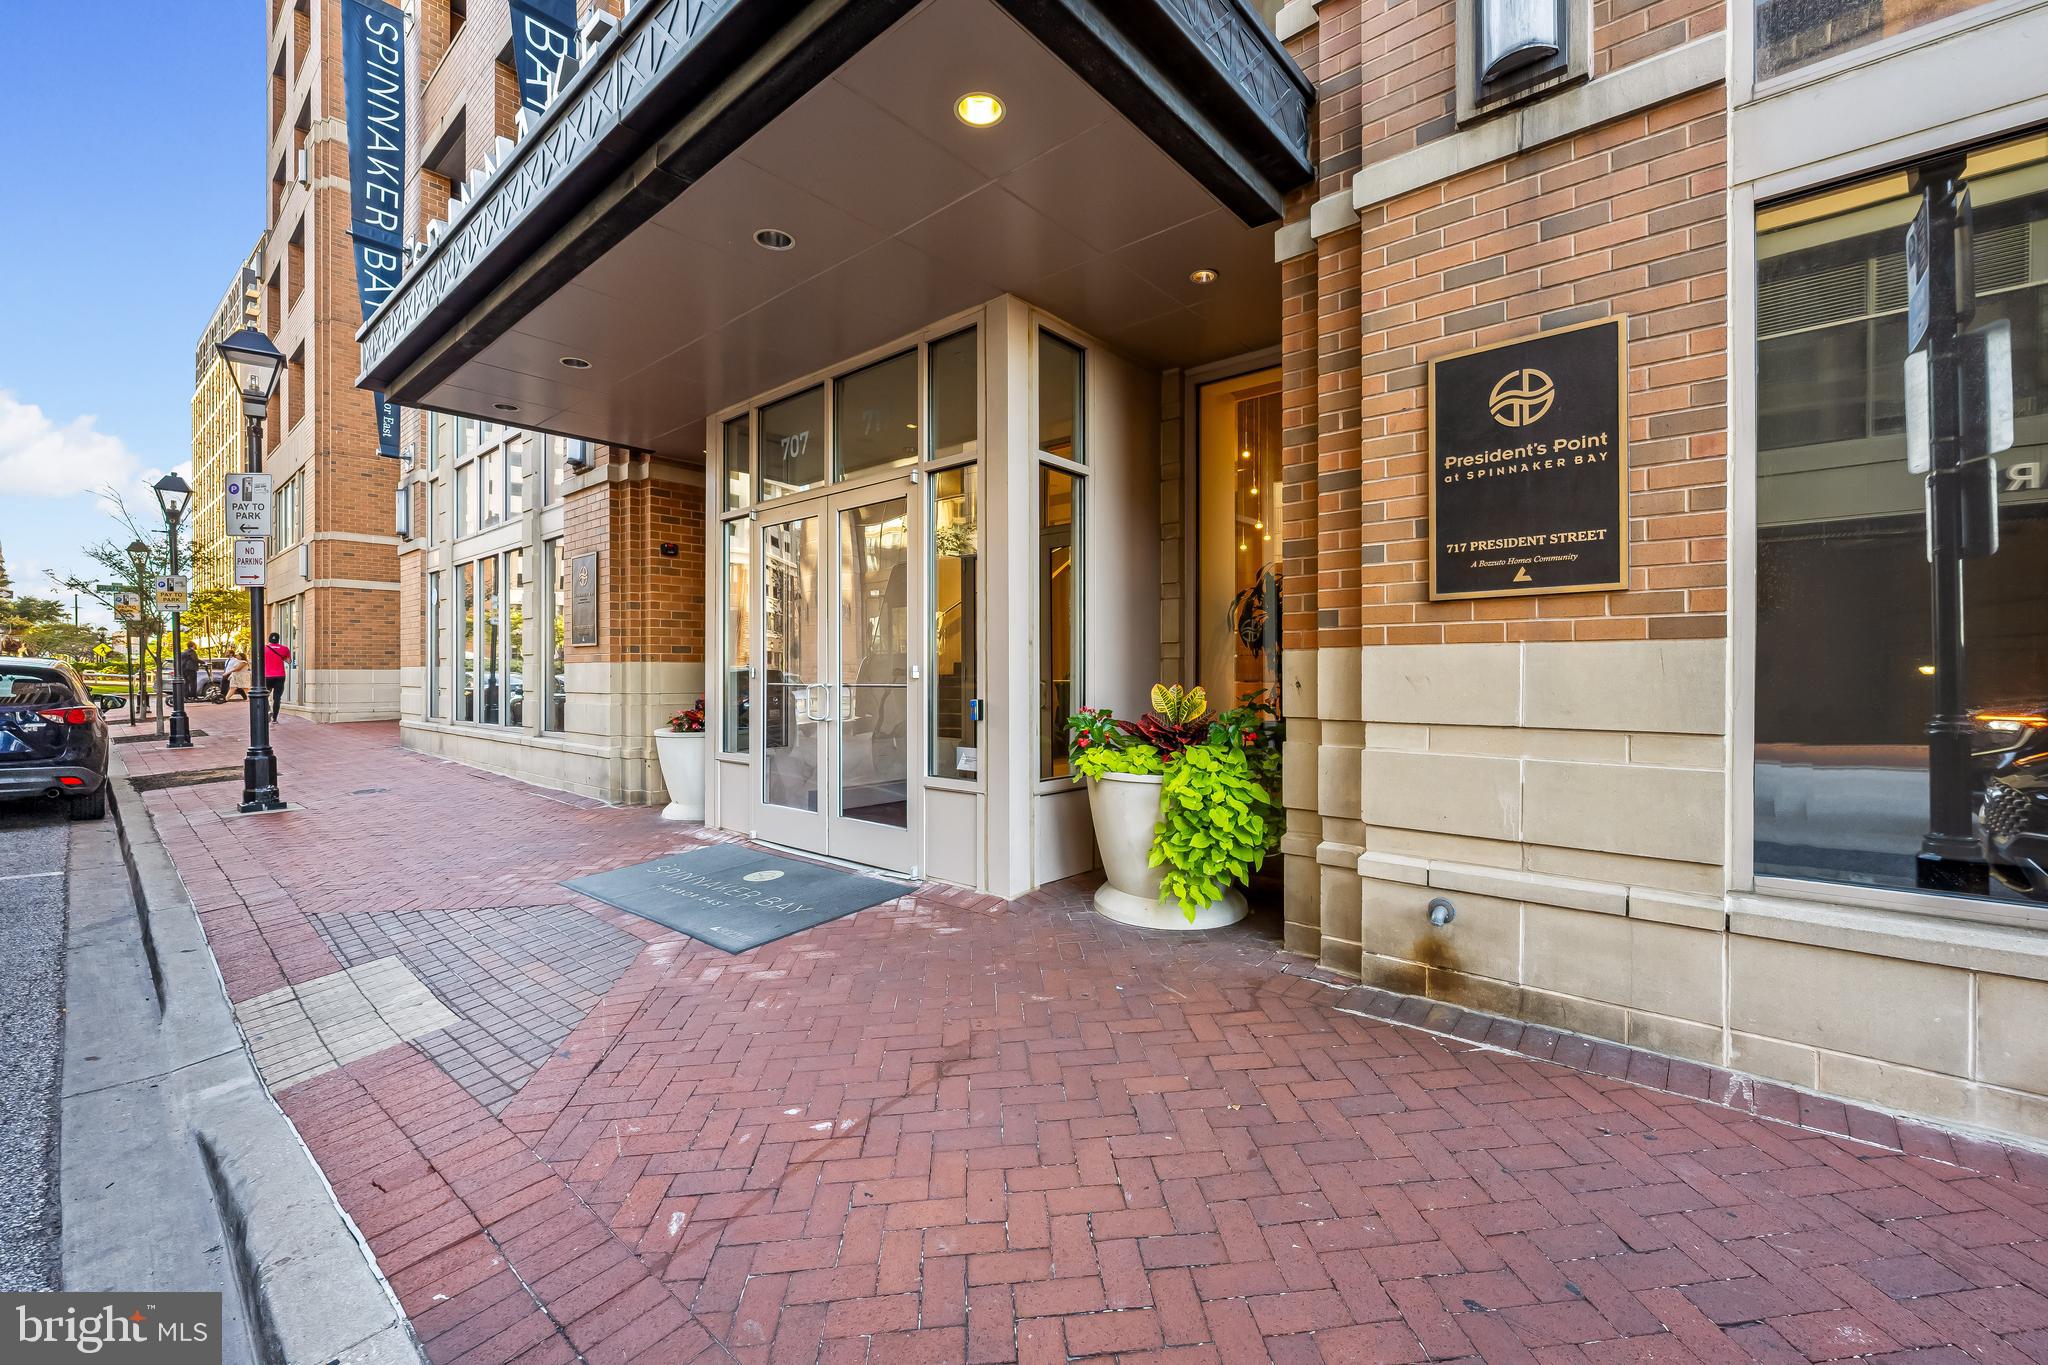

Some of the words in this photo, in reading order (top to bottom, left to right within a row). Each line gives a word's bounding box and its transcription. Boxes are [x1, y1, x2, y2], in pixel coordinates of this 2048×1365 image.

[365, 14, 399, 234] SPINNAKER
[382, 416, 394, 437] East
[781, 430, 810, 460] 707
[1444, 442, 1547, 469] President's
[1553, 432, 1608, 453] Point
[1444, 473, 1460, 483] at
[1466, 458, 1566, 480] SPINNAKER
[1574, 451, 1608, 465] BAY
[232, 503, 250, 511] PAY
[252, 503, 265, 511] TO
[235, 512, 261, 520] PARK
[245, 547, 255, 555] NO
[1446, 543, 1467, 554] 717
[1470, 535, 1547, 552] PRESIDENT
[1550, 529, 1607, 544] STREET
[237, 558, 263, 566] PARKING
[1479, 559, 1506, 567] Bozzuto
[1507, 557, 1532, 565] Homes
[1533, 553, 1579, 563] Community
[646, 864, 762, 900] SPINNAKER
[754, 896, 814, 915] BAY
